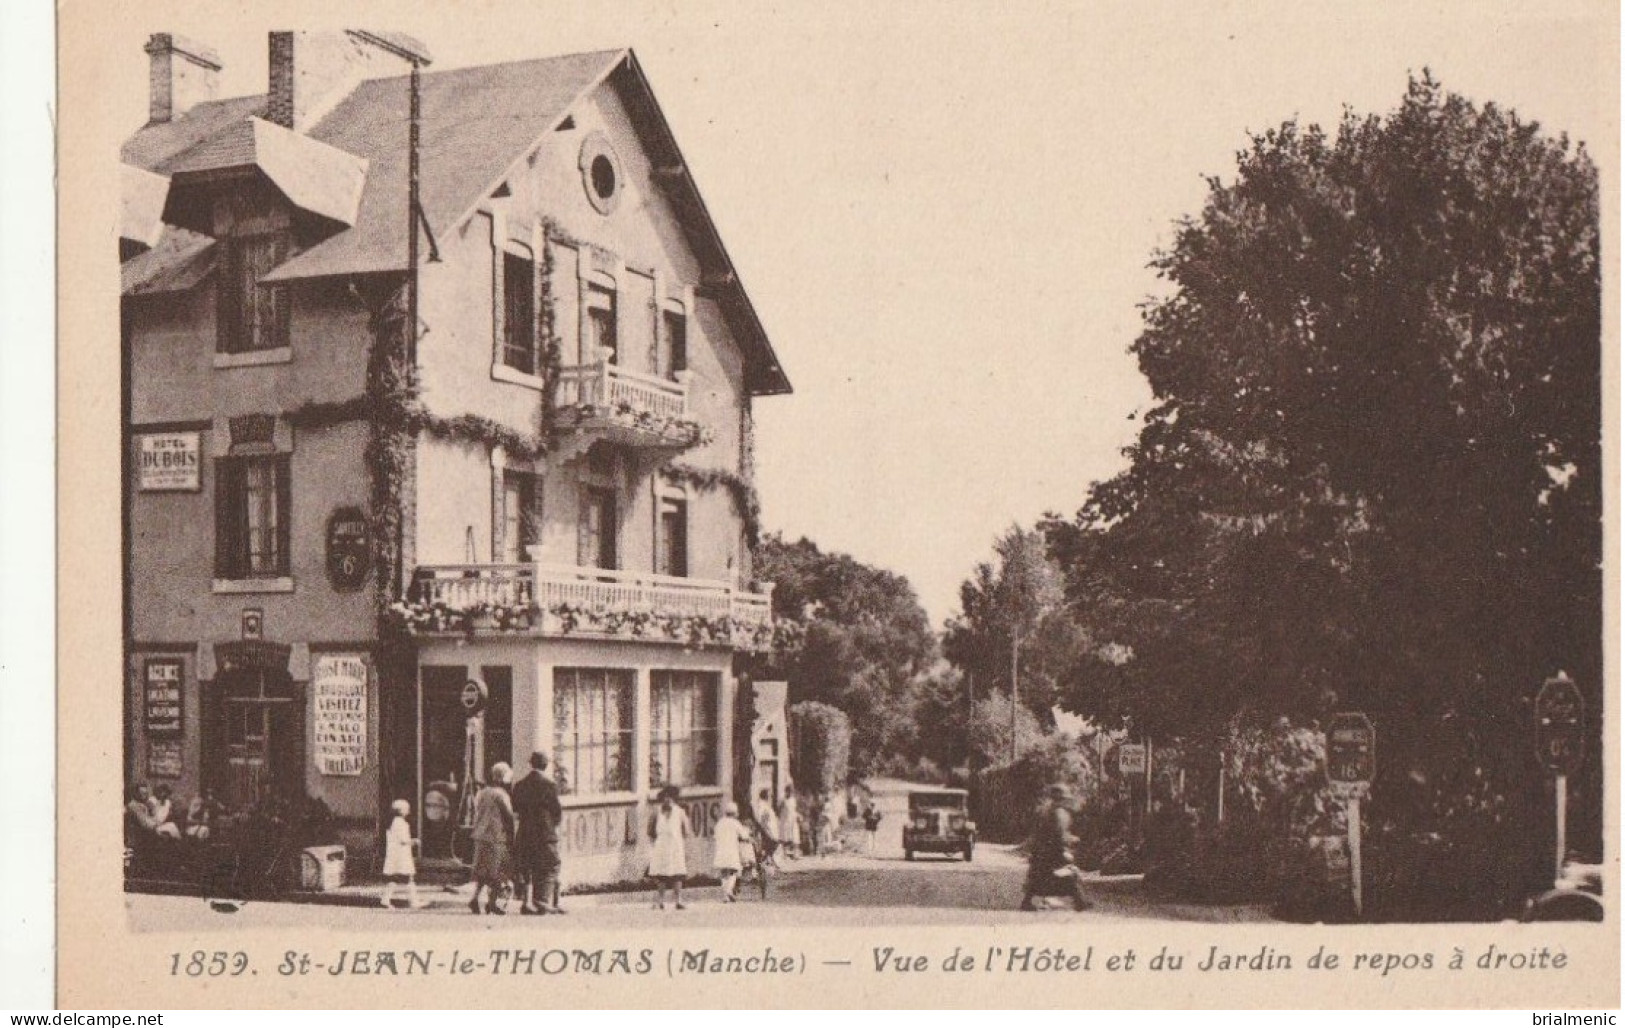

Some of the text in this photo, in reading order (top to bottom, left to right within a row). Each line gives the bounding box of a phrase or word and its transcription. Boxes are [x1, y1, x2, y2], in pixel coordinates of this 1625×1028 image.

[154, 439, 186, 448] HOTEL
[143, 450, 196, 468] DUBOIS
[319, 698, 361, 711] VISITEZ
[562, 807, 637, 855] HOTEL
